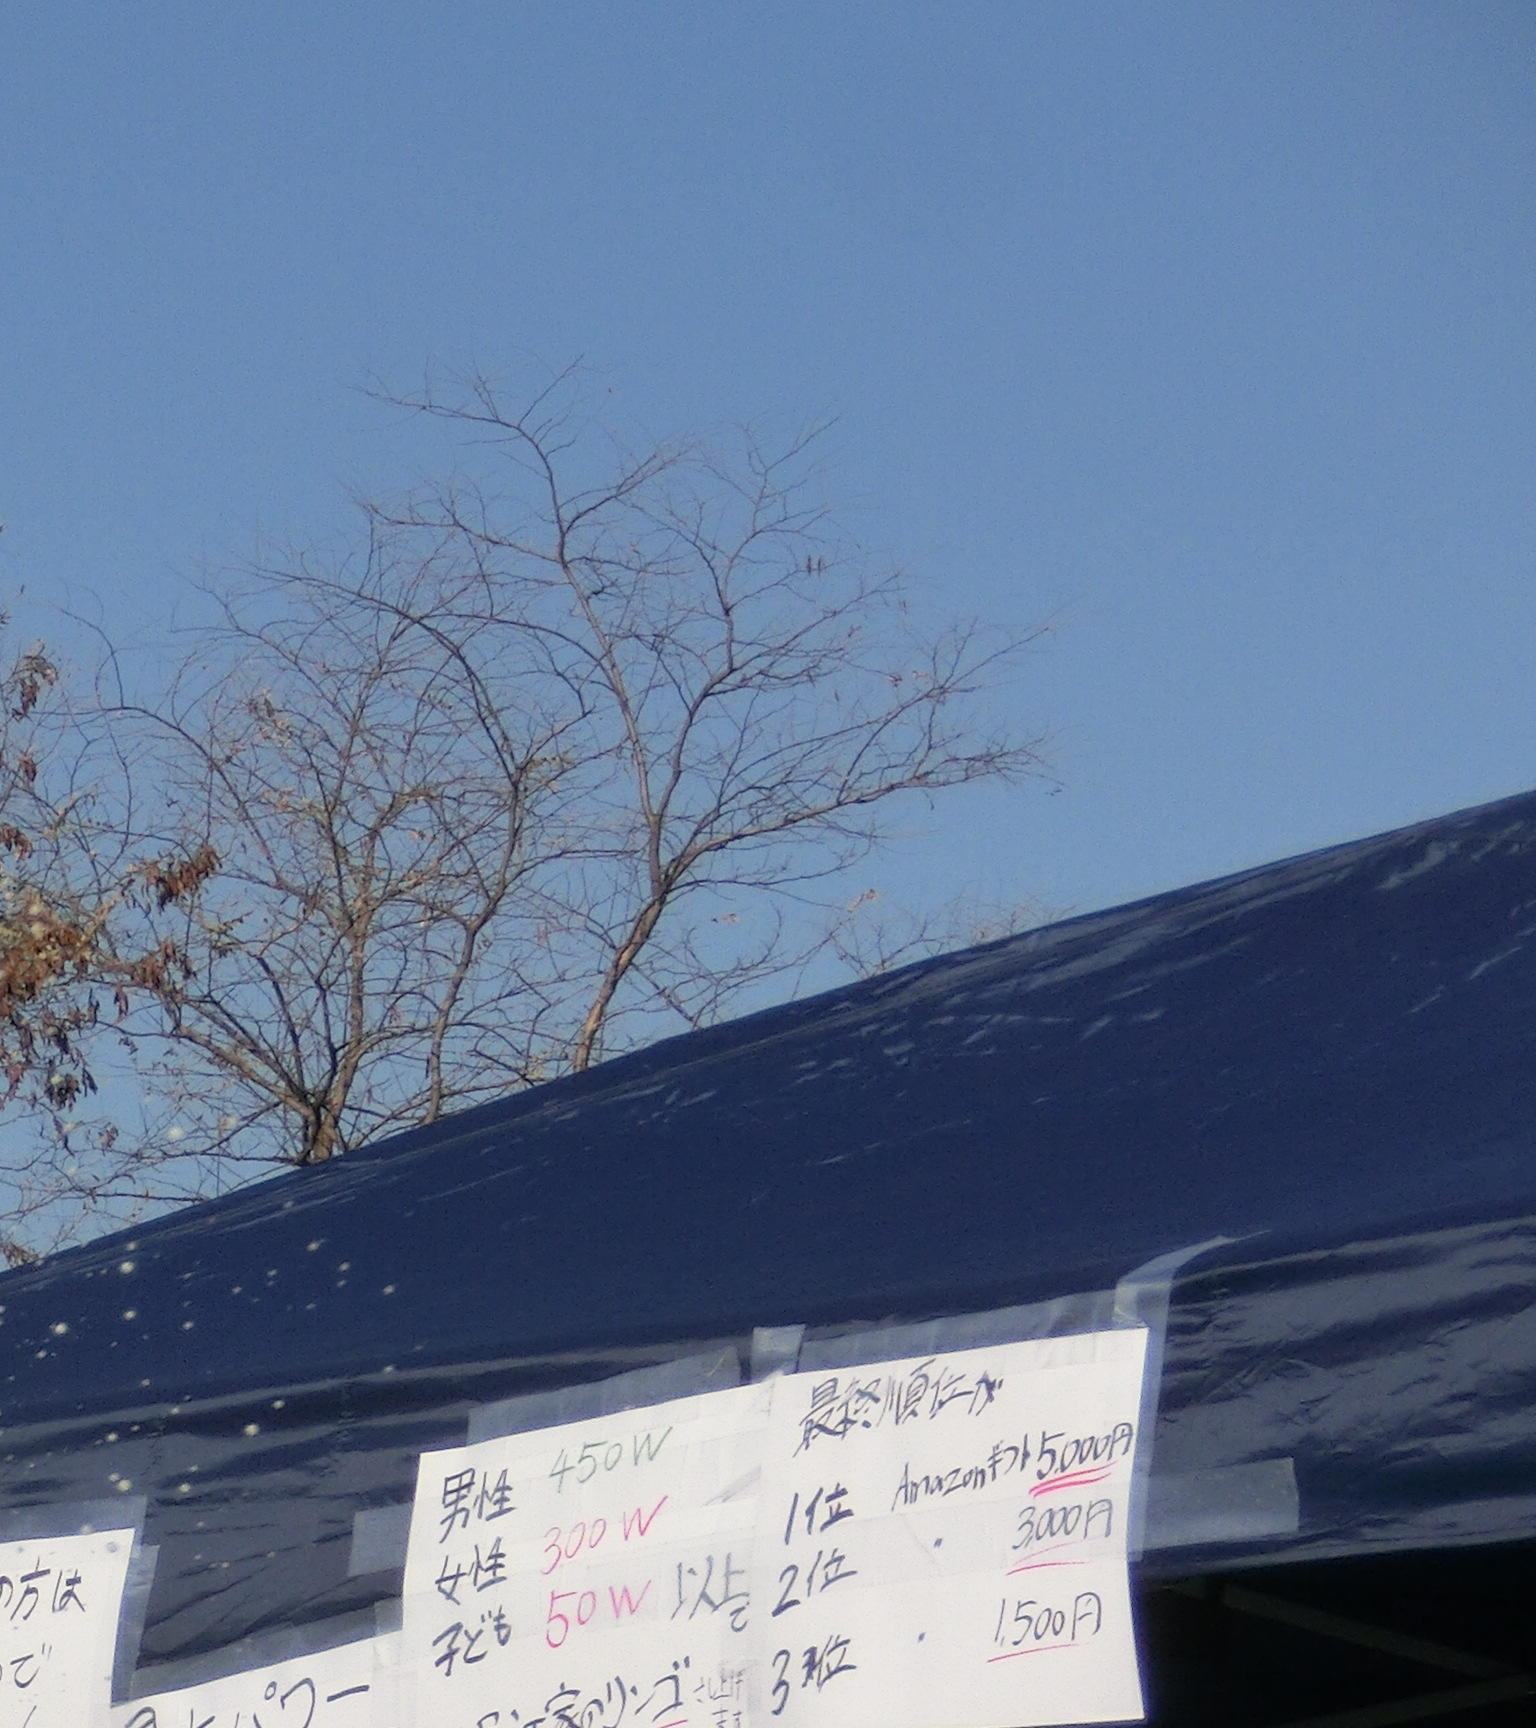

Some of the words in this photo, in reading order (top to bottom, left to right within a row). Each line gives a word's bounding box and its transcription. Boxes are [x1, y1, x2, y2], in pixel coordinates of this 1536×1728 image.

[439, 1467, 516, 1544] 男性
[549, 1426, 674, 1495] 450W
[784, 1482, 855, 1546] 1位
[435, 1536, 507, 1606] 女性
[540, 1495, 669, 1576] 300W
[772, 1548, 858, 1618] 2位
[432, 1604, 512, 1678] 子ども
